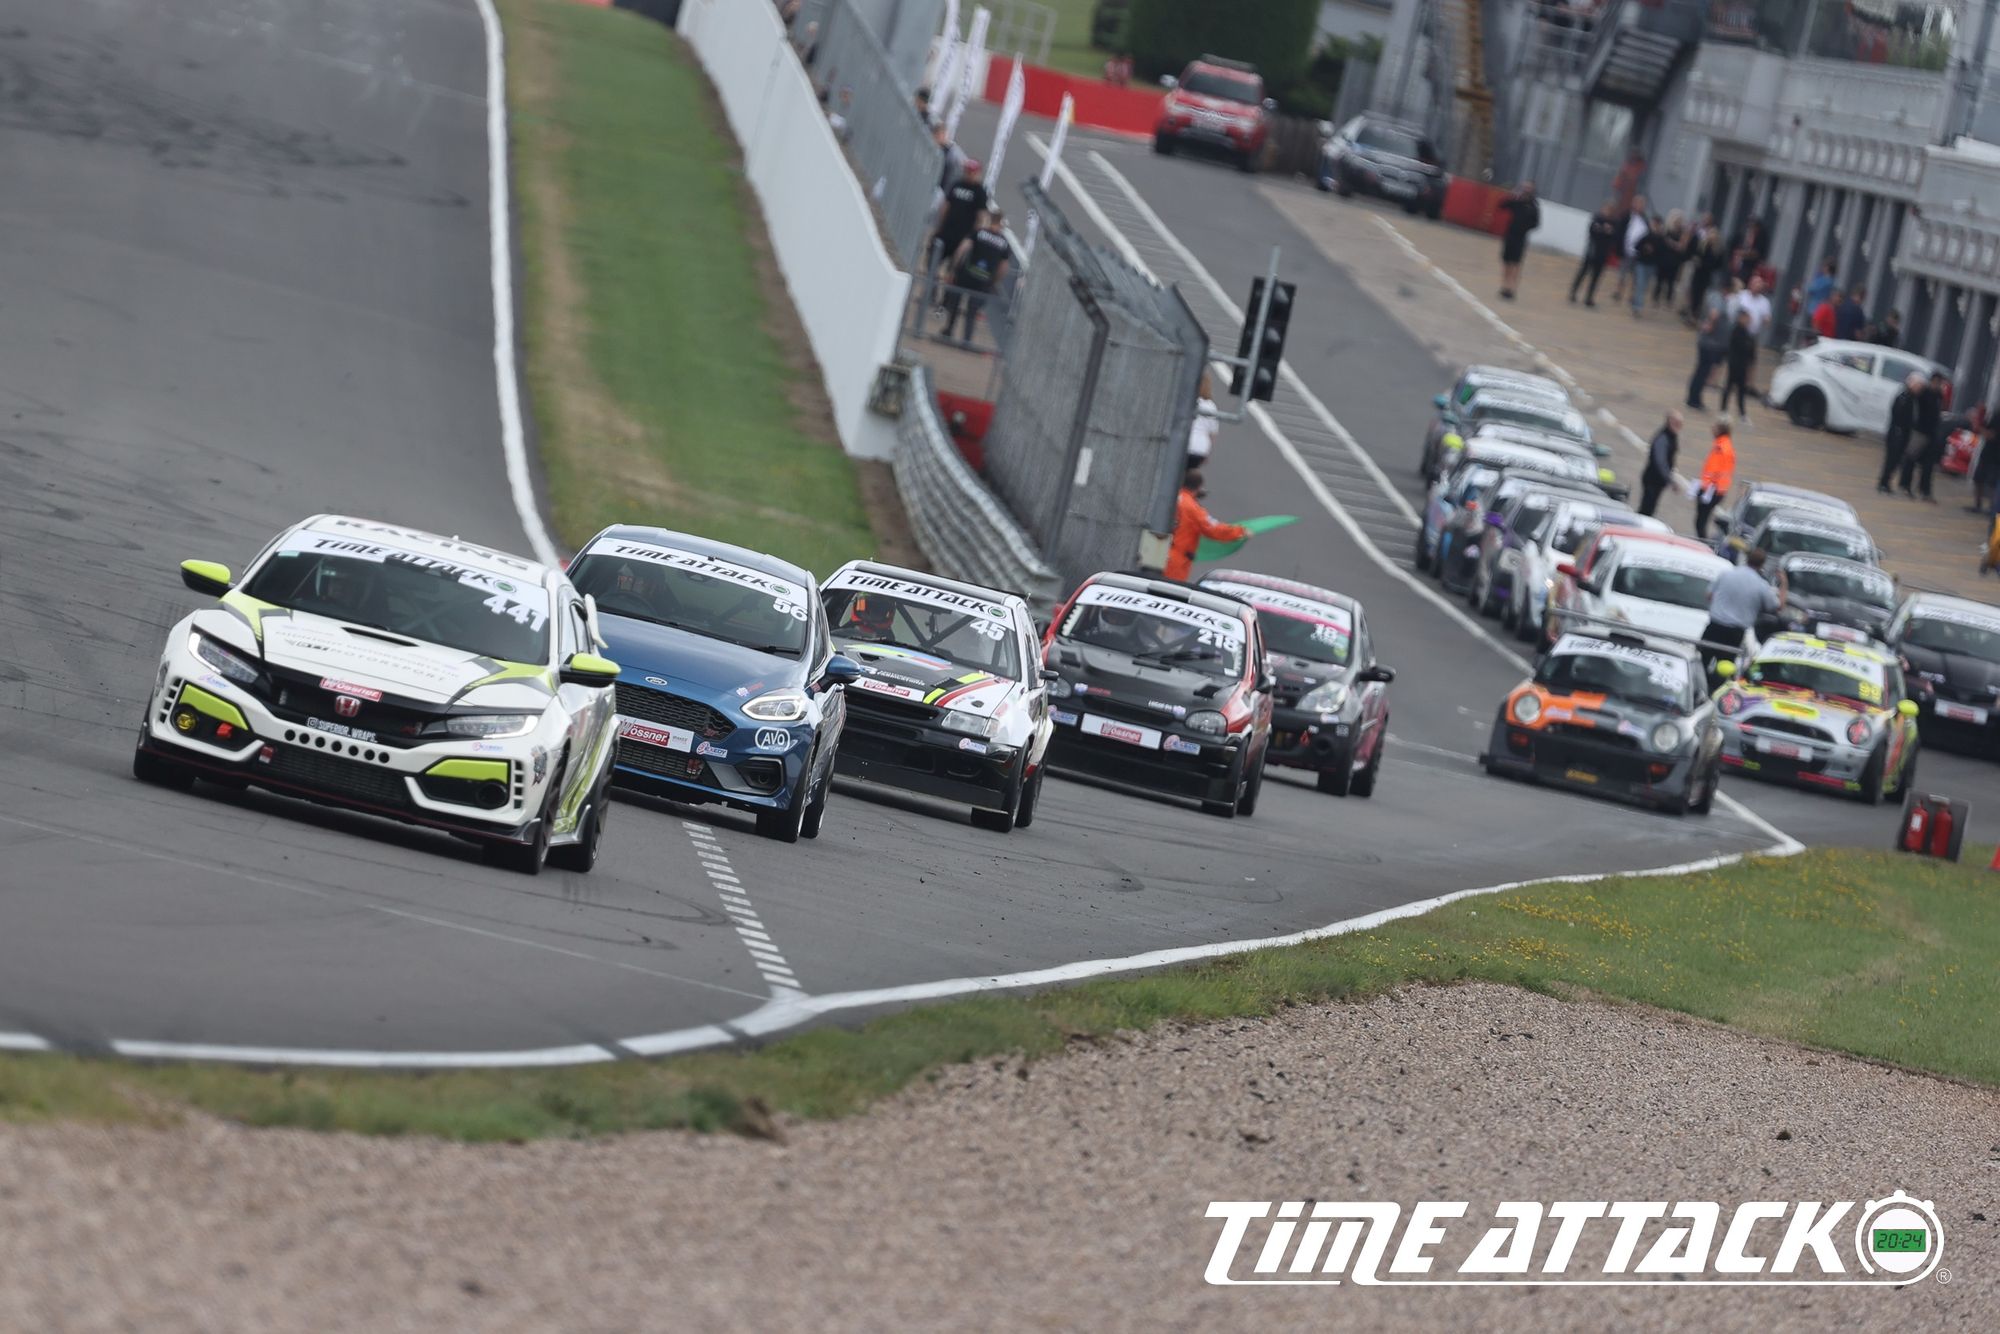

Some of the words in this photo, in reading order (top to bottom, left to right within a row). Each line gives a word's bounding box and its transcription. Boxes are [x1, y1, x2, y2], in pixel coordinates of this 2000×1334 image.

[388, 551, 493, 585] ATTACK
[679, 557, 769, 589] ATTACK
[772, 597, 808, 622] 56
[904, 586, 986, 614] ATTACK
[483, 594, 549, 633] 441
[1146, 601, 1217, 625] ATTACK
[969, 619, 1006, 641] 45
[1197, 627, 1241, 652] 218
[760, 731, 786, 749] AVO
